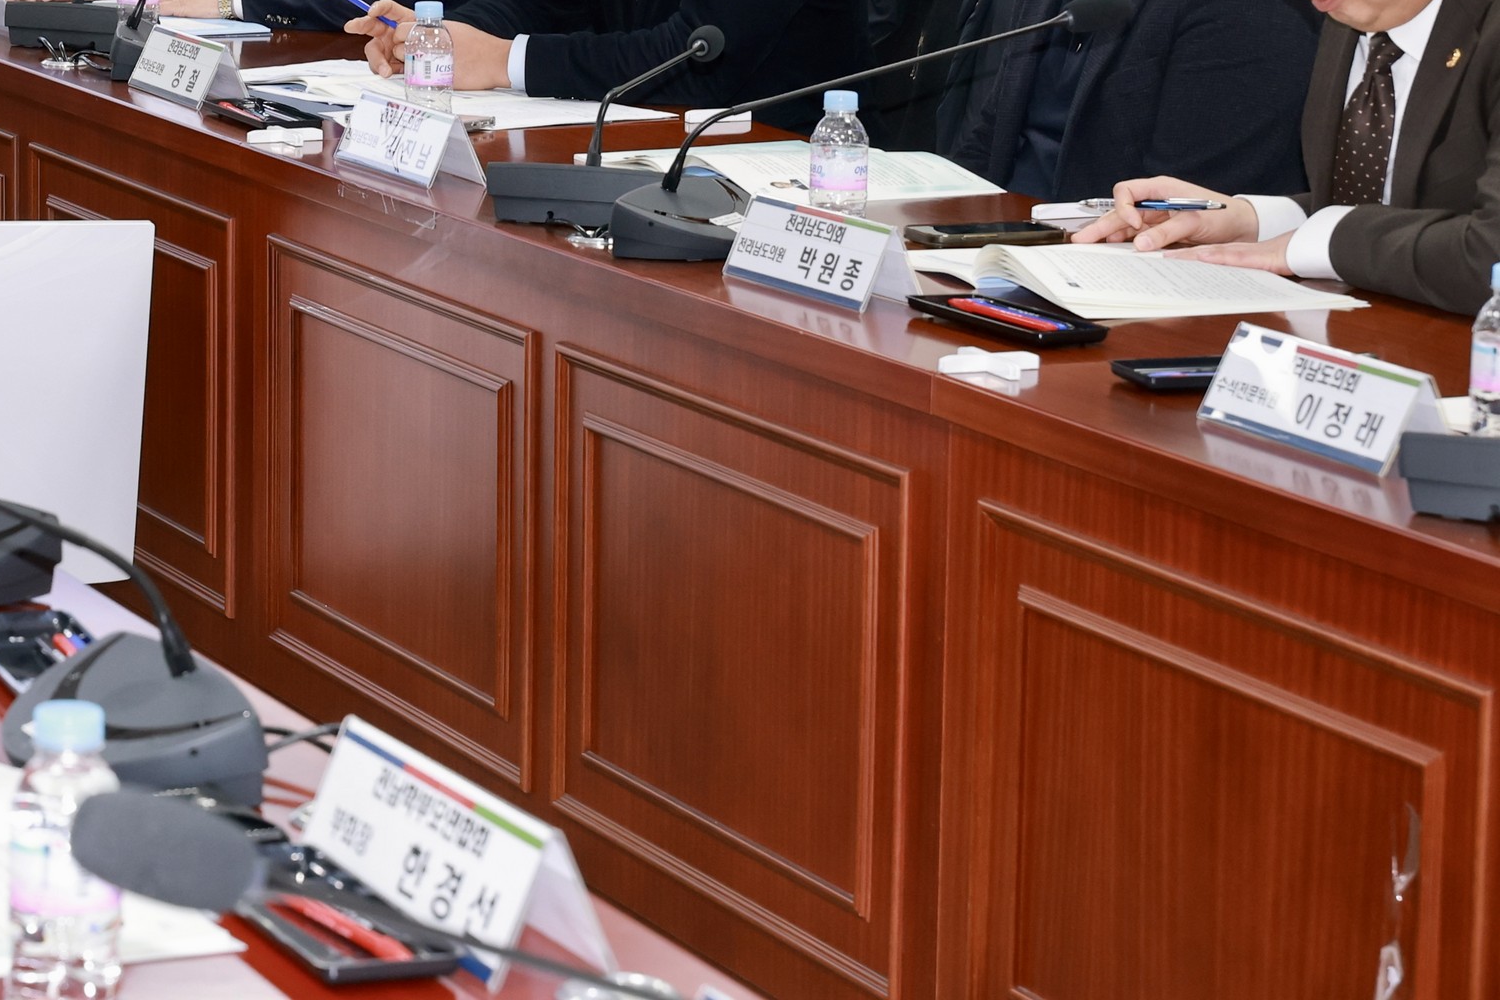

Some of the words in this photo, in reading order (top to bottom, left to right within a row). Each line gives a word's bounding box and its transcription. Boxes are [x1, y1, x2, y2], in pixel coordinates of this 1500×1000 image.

[167, 39, 201, 61] 전라남도의회
[785, 213, 847, 245] 전라남도의회
[737, 237, 787, 264] 전라남도의원
[797, 246, 863, 292] 박원종
[1292, 356, 1362, 394] 라남도의회
[1295, 393, 1385, 449] 이정래
